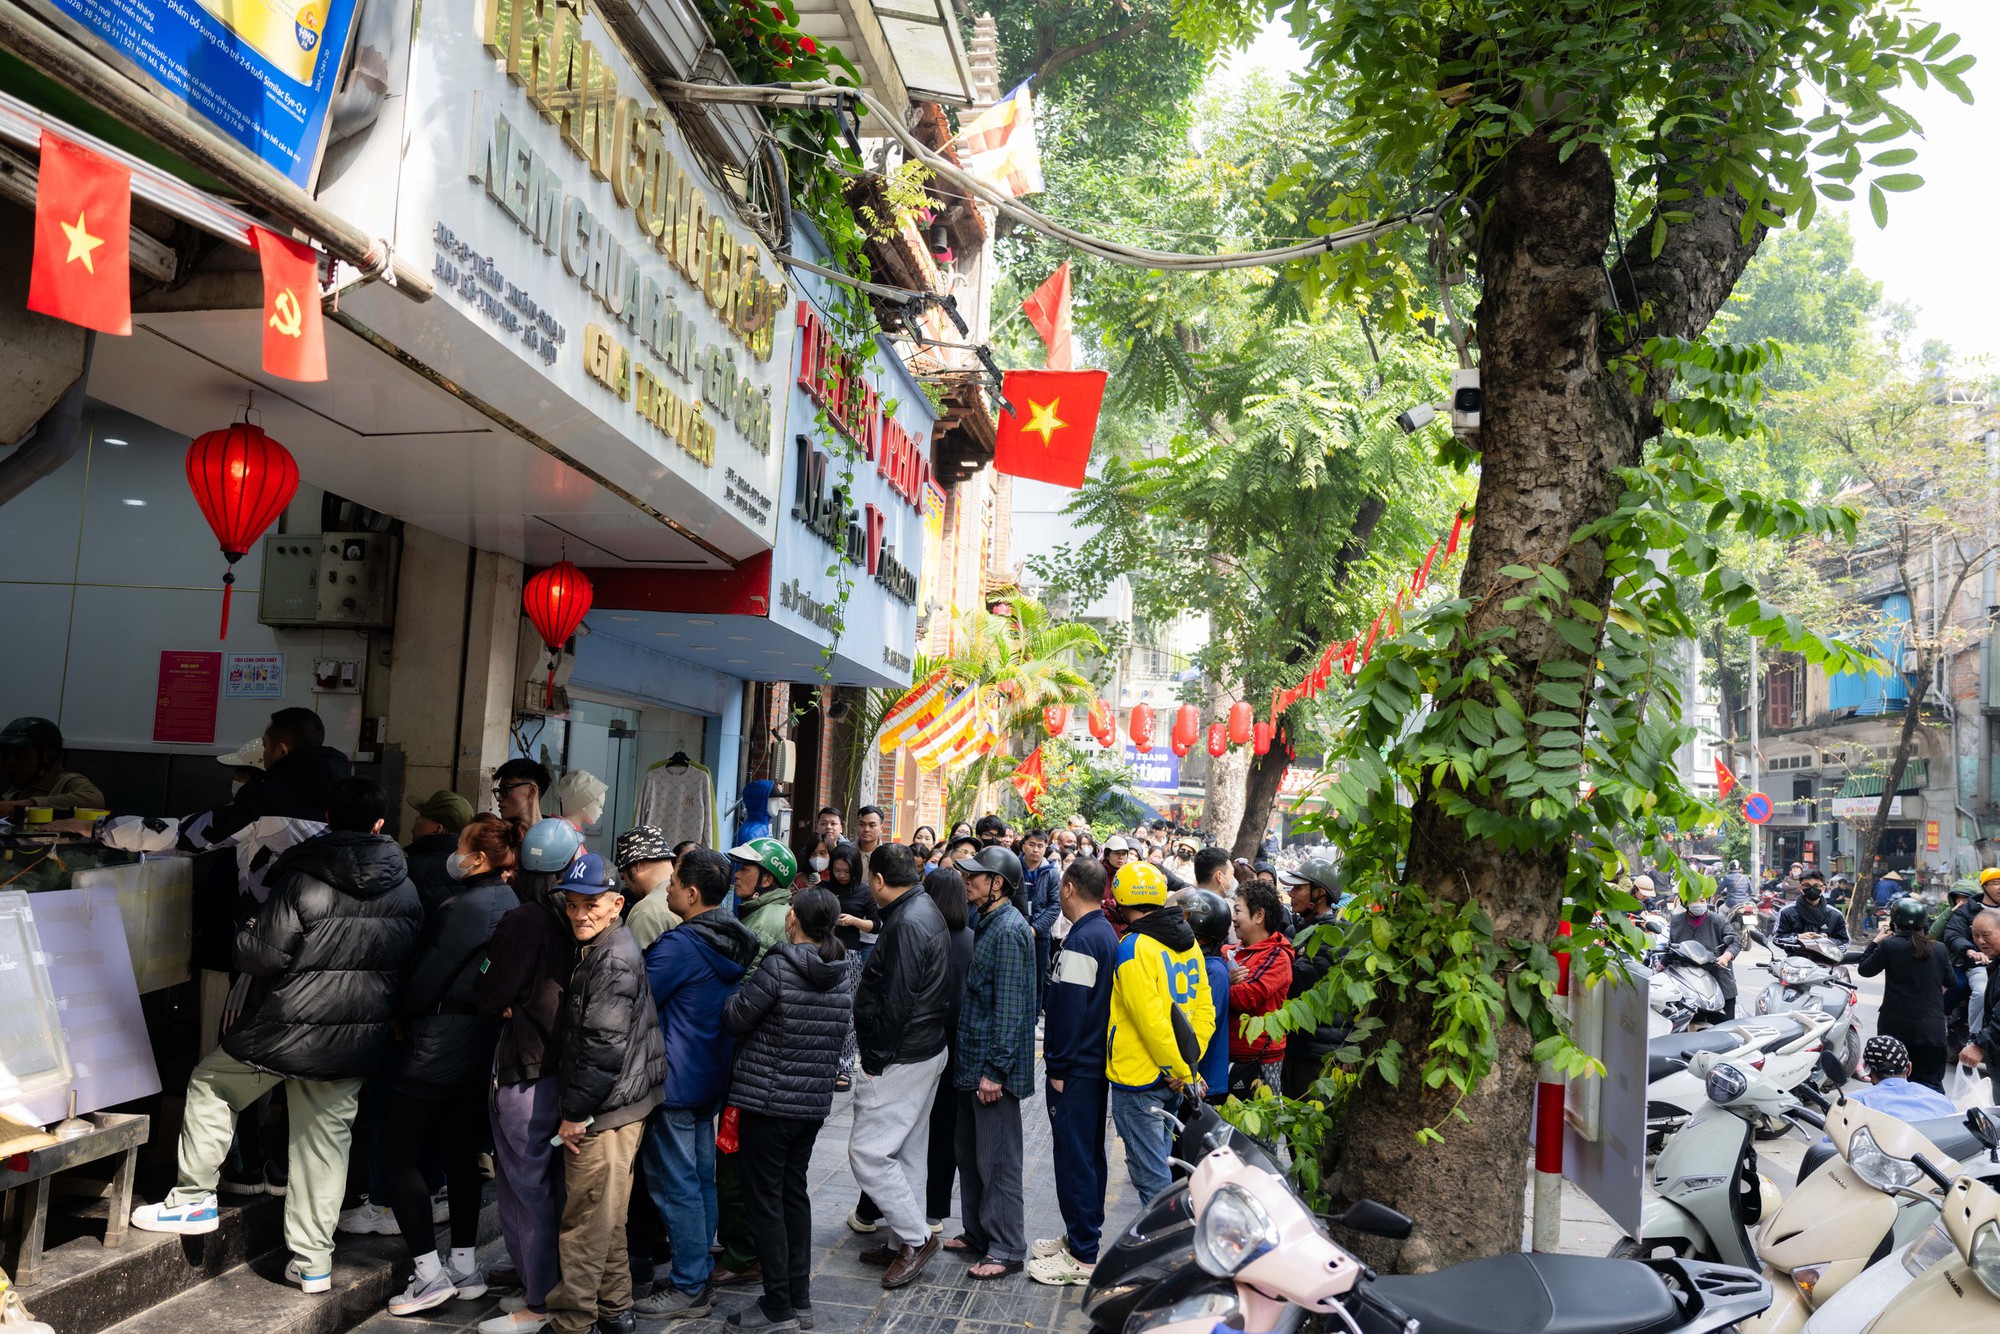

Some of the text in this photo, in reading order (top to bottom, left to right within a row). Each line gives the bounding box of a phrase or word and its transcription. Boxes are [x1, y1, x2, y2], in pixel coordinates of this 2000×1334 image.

[83, 7, 93, 19] 38
[92, 14, 102, 26] 25
[102, 21, 111, 32] 65
[123, 37, 135, 50] 521
[135, 46, 148, 60] Kim
[159, 63, 167, 75] Ba
[201, 95, 216, 111] (024)
[215, 106, 224, 116] 37
[222, 111, 230, 122] 33
[141, 38, 168, 63] prebiotic
[227, 103, 242, 119] trong
[200, 25, 217, 45] sung
[216, 36, 230, 54] cho
[240, 56, 250, 71] 2-6
[263, 75, 286, 99] Similac
[284, 90, 302, 113] Eye-Q
[301, 108, 307, 116] 4
[298, 27, 315, 46] HMO
[611, 95, 708, 290] CÔNG
[432, 252, 458, 287] HAI
[458, 273, 477, 301] BÀ
[477, 287, 518, 333] TRƯNG
[521, 324, 538, 351] HÀ
[468, 90, 562, 256] NEM
[561, 195, 640, 335] CHUA
[640, 276, 697, 384] RÁN
[702, 342, 739, 422] GIÒ
[470, 250, 504, 293] TRẦN
[505, 281, 538, 320] XUÂN
[584, 323, 717, 468] GIA TRUYỀN
[877, 410, 932, 516] PHÚC
[770, 856, 790, 877] Grab
[1161, 950, 1200, 1004] be
